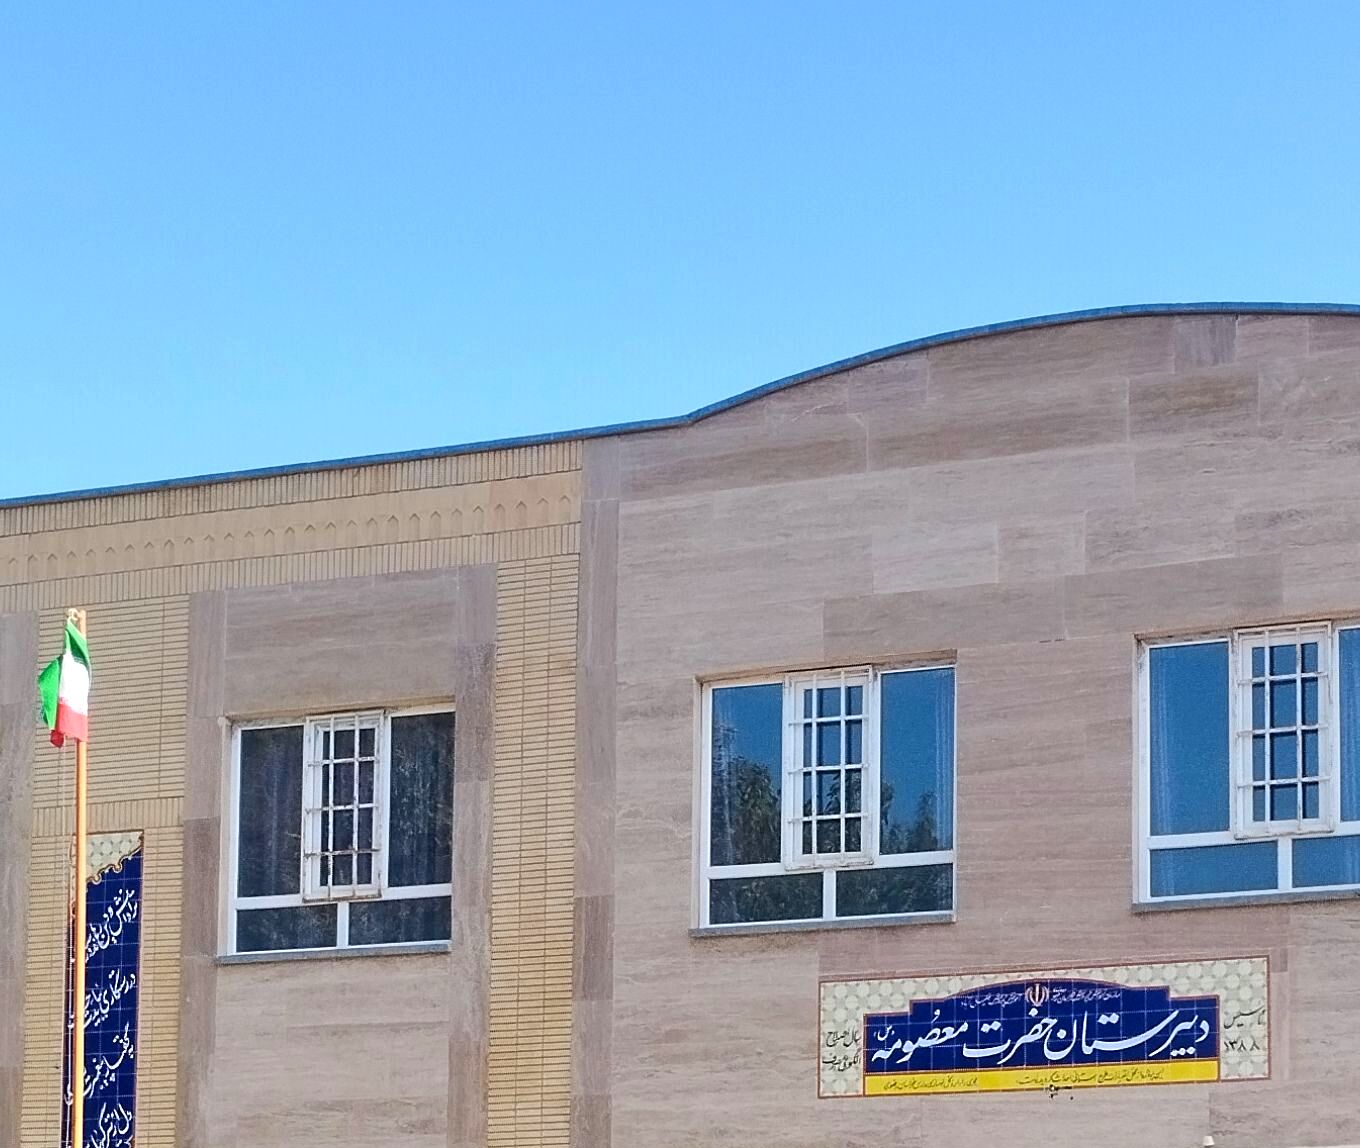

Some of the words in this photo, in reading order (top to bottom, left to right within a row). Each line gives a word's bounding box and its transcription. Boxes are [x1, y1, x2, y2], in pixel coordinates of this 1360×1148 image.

[963, 1007, 1058, 1065] حضرت
[1044, 1010, 1209, 1061] دبیرستان
[1224, 1036, 1260, 1051] ۱۳۸۸
